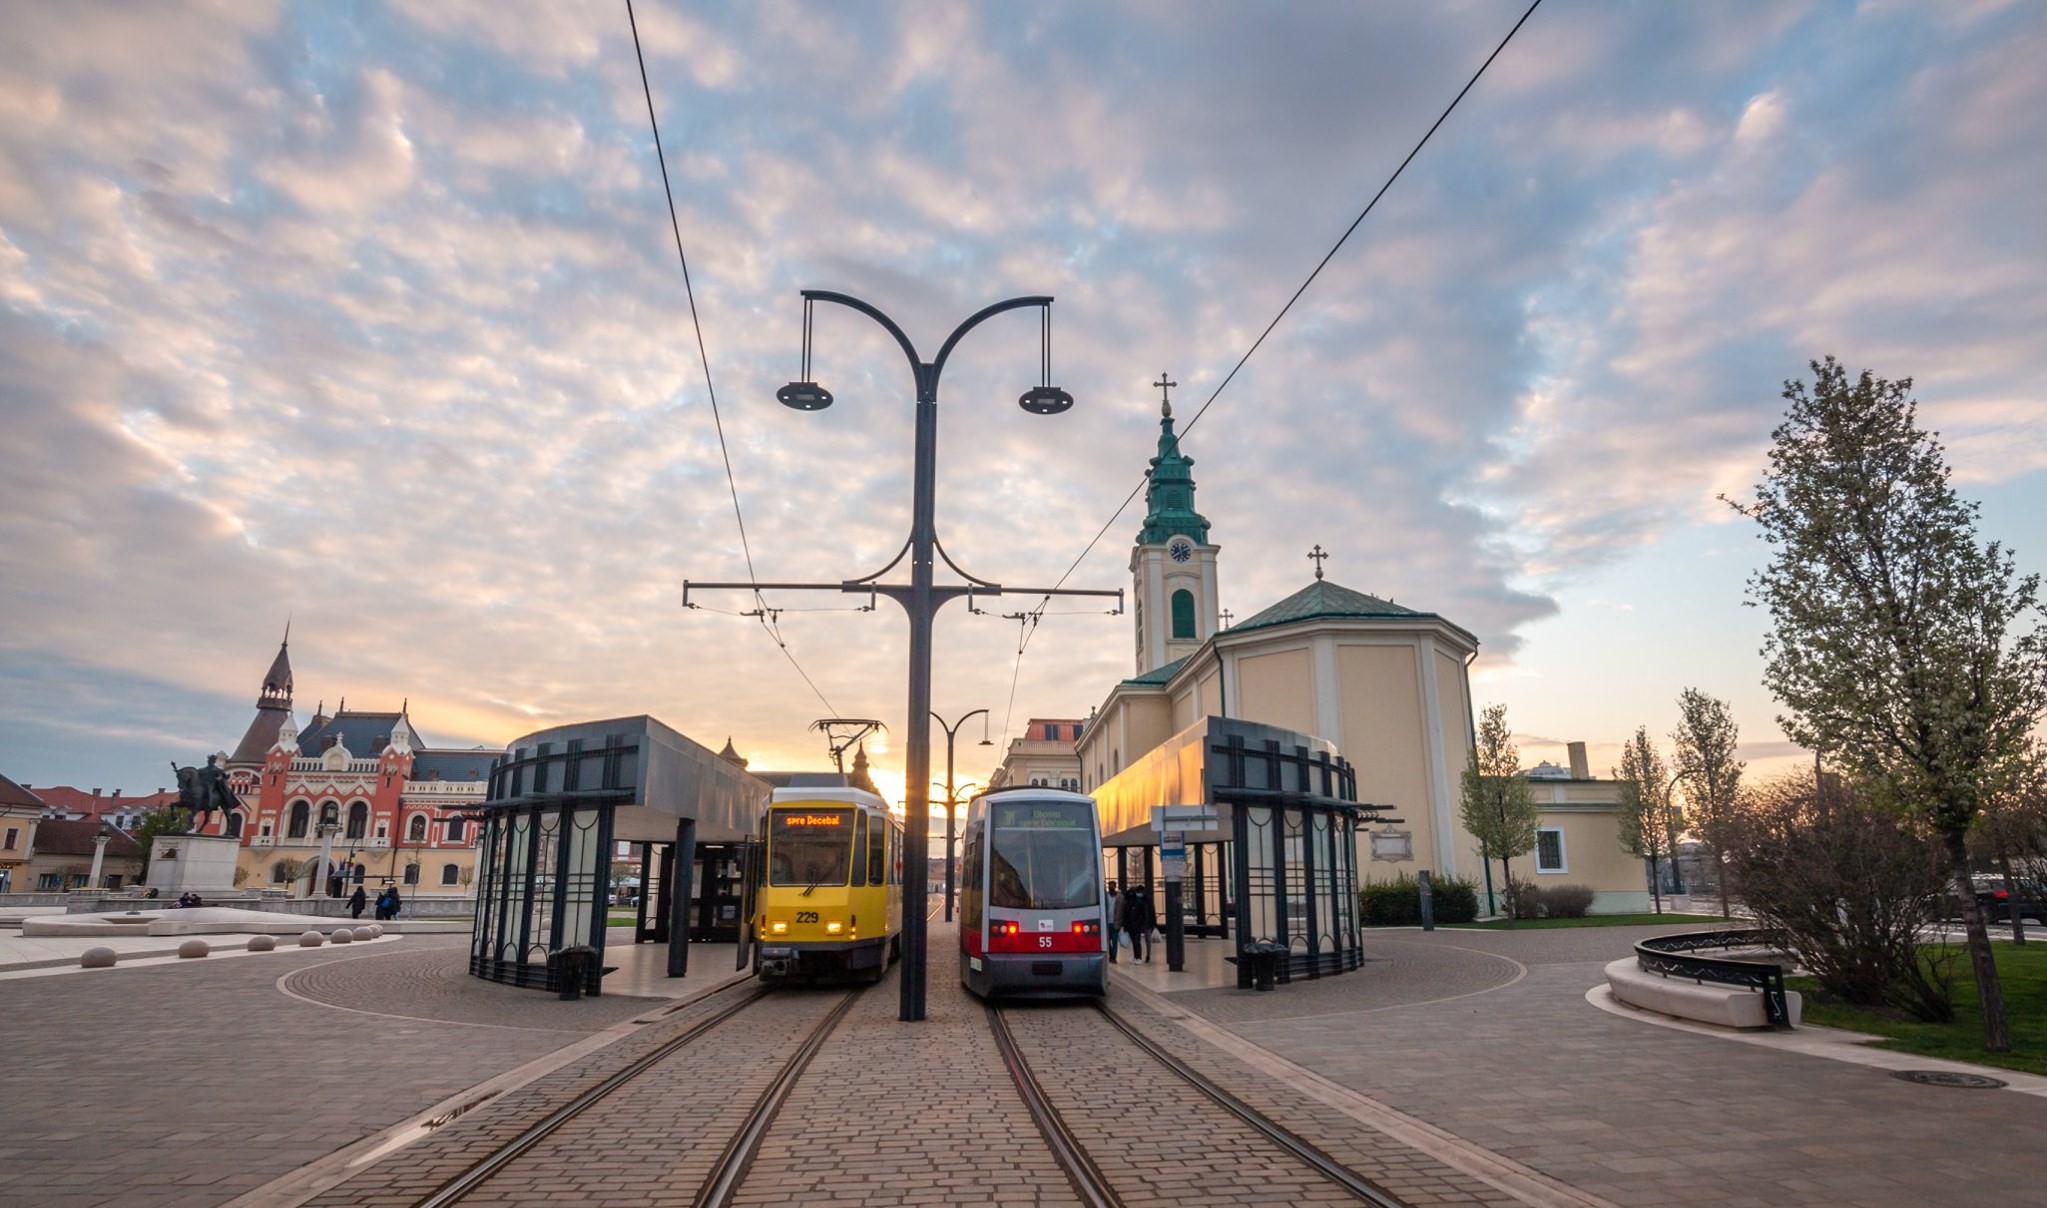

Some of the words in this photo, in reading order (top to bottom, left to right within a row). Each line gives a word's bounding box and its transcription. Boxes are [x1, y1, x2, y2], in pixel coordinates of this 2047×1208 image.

[807, 815, 839, 825] Decebal
[796, 911, 819, 924] 229
[1039, 936, 1052, 948] 55
